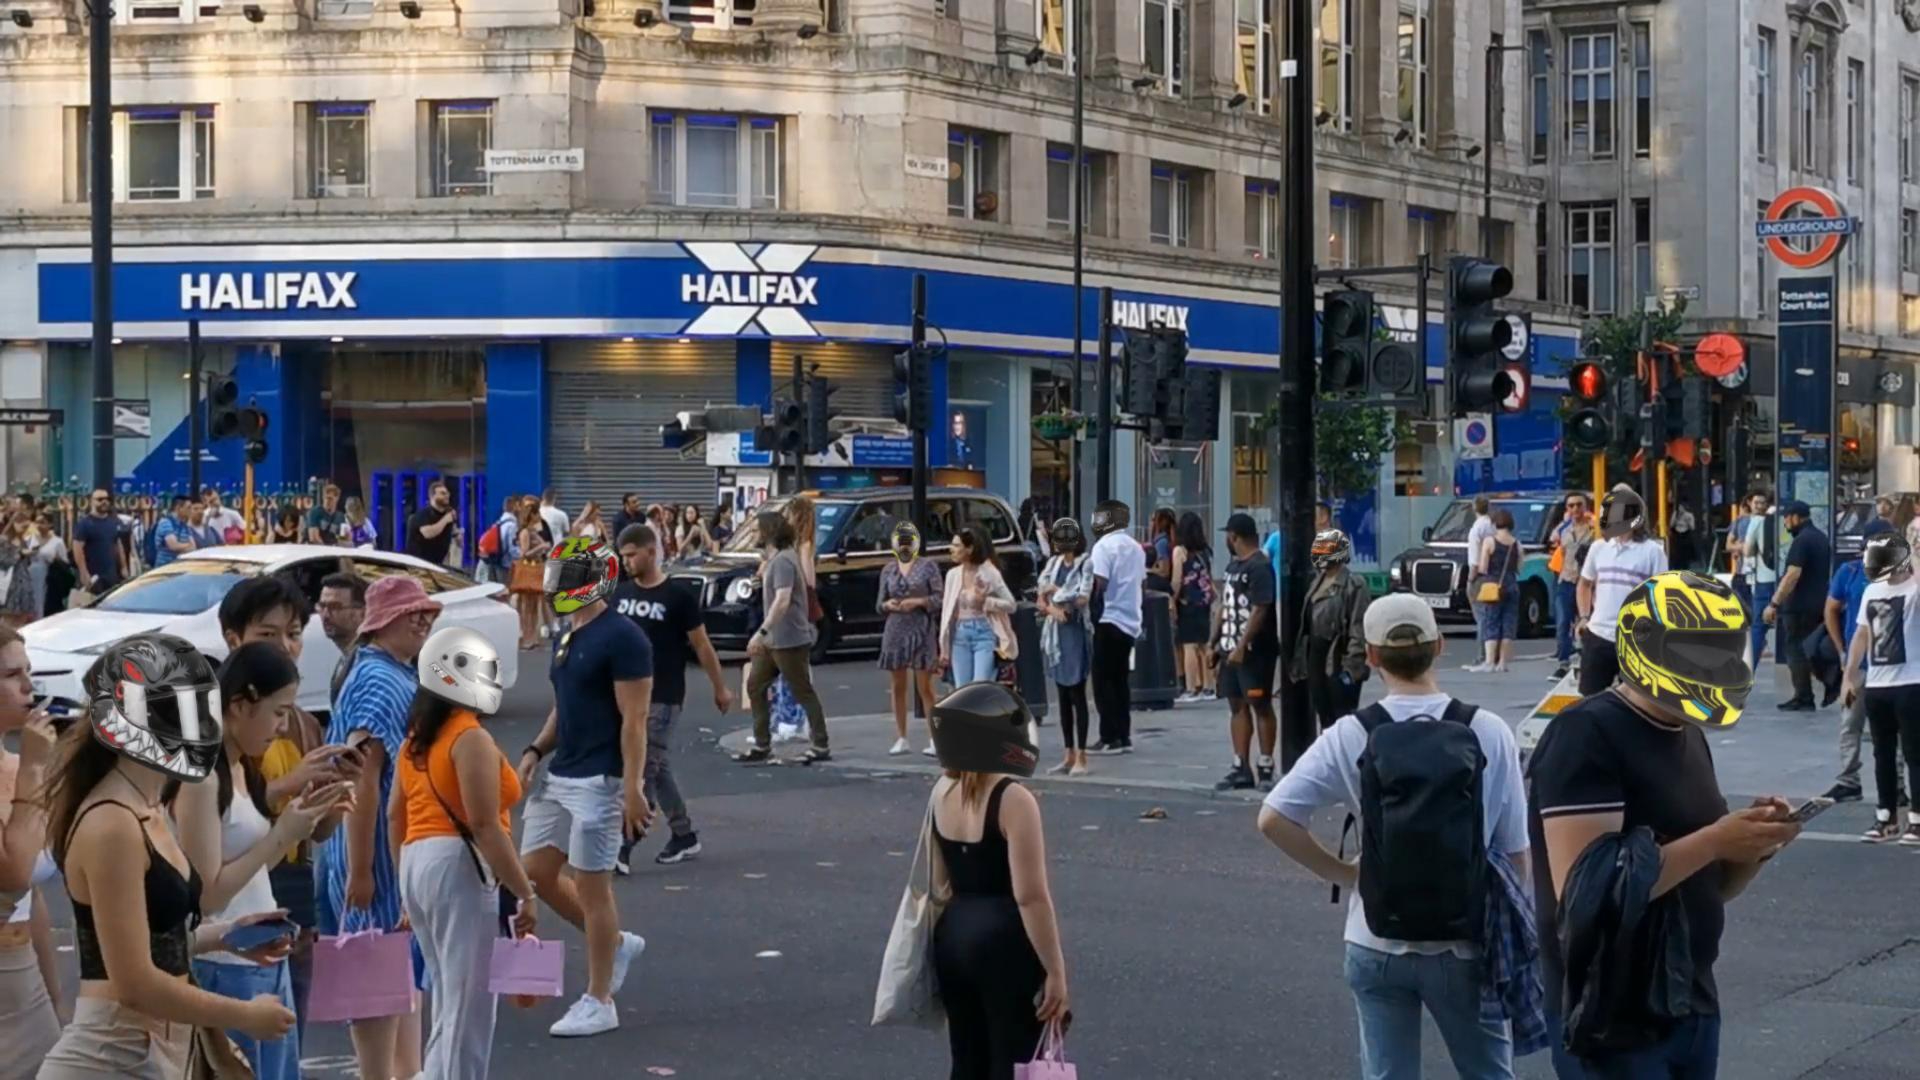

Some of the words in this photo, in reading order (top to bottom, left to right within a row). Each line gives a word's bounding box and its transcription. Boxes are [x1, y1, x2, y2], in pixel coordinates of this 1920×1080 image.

[490, 155, 546, 166] TOTTENHAM
[1758, 220, 1847, 234] UNDERGROUND
[180, 271, 358, 310] HALIFAX
[681, 273, 819, 305] HALIFAX
[1780, 291, 1829, 301] Tottenham
[1779, 301, 1805, 311] Court
[1806, 300, 1830, 310] Road
[616, 598, 667, 621] DIOR
